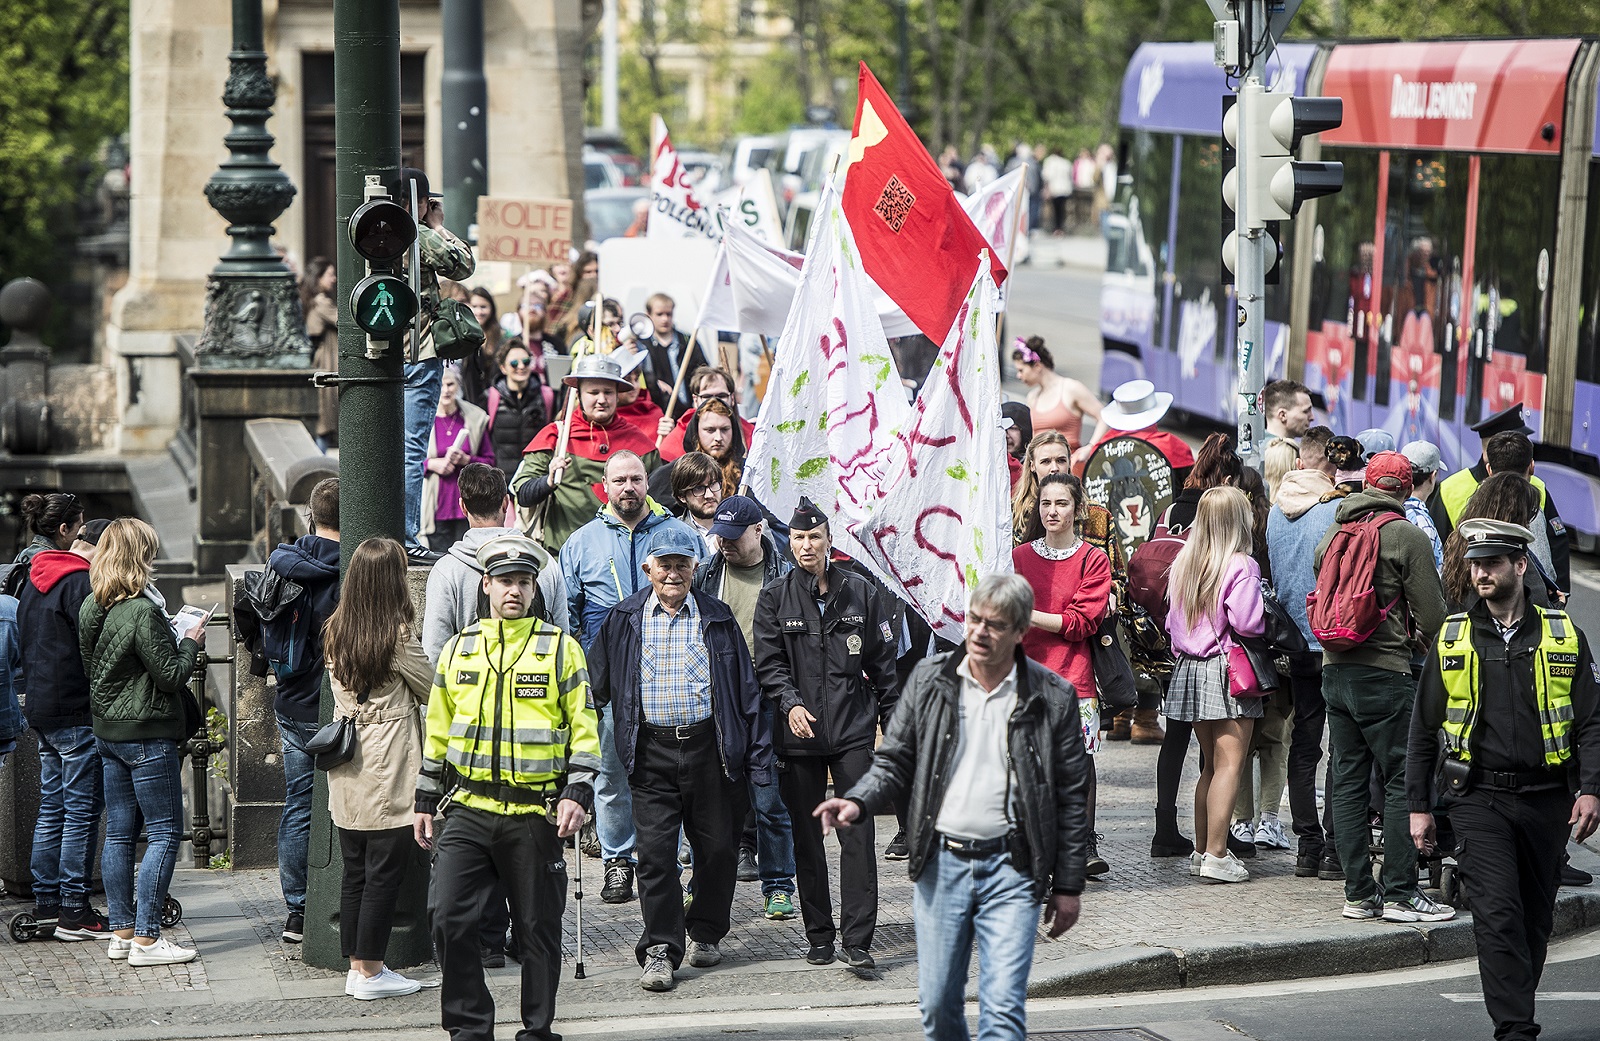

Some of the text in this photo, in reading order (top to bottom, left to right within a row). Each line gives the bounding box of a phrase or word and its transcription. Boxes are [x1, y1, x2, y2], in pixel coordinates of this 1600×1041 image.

[1548, 654, 1577, 662] POLICIE
[516, 674, 548, 682] POLICIE
[517, 688, 544, 697] 305256
